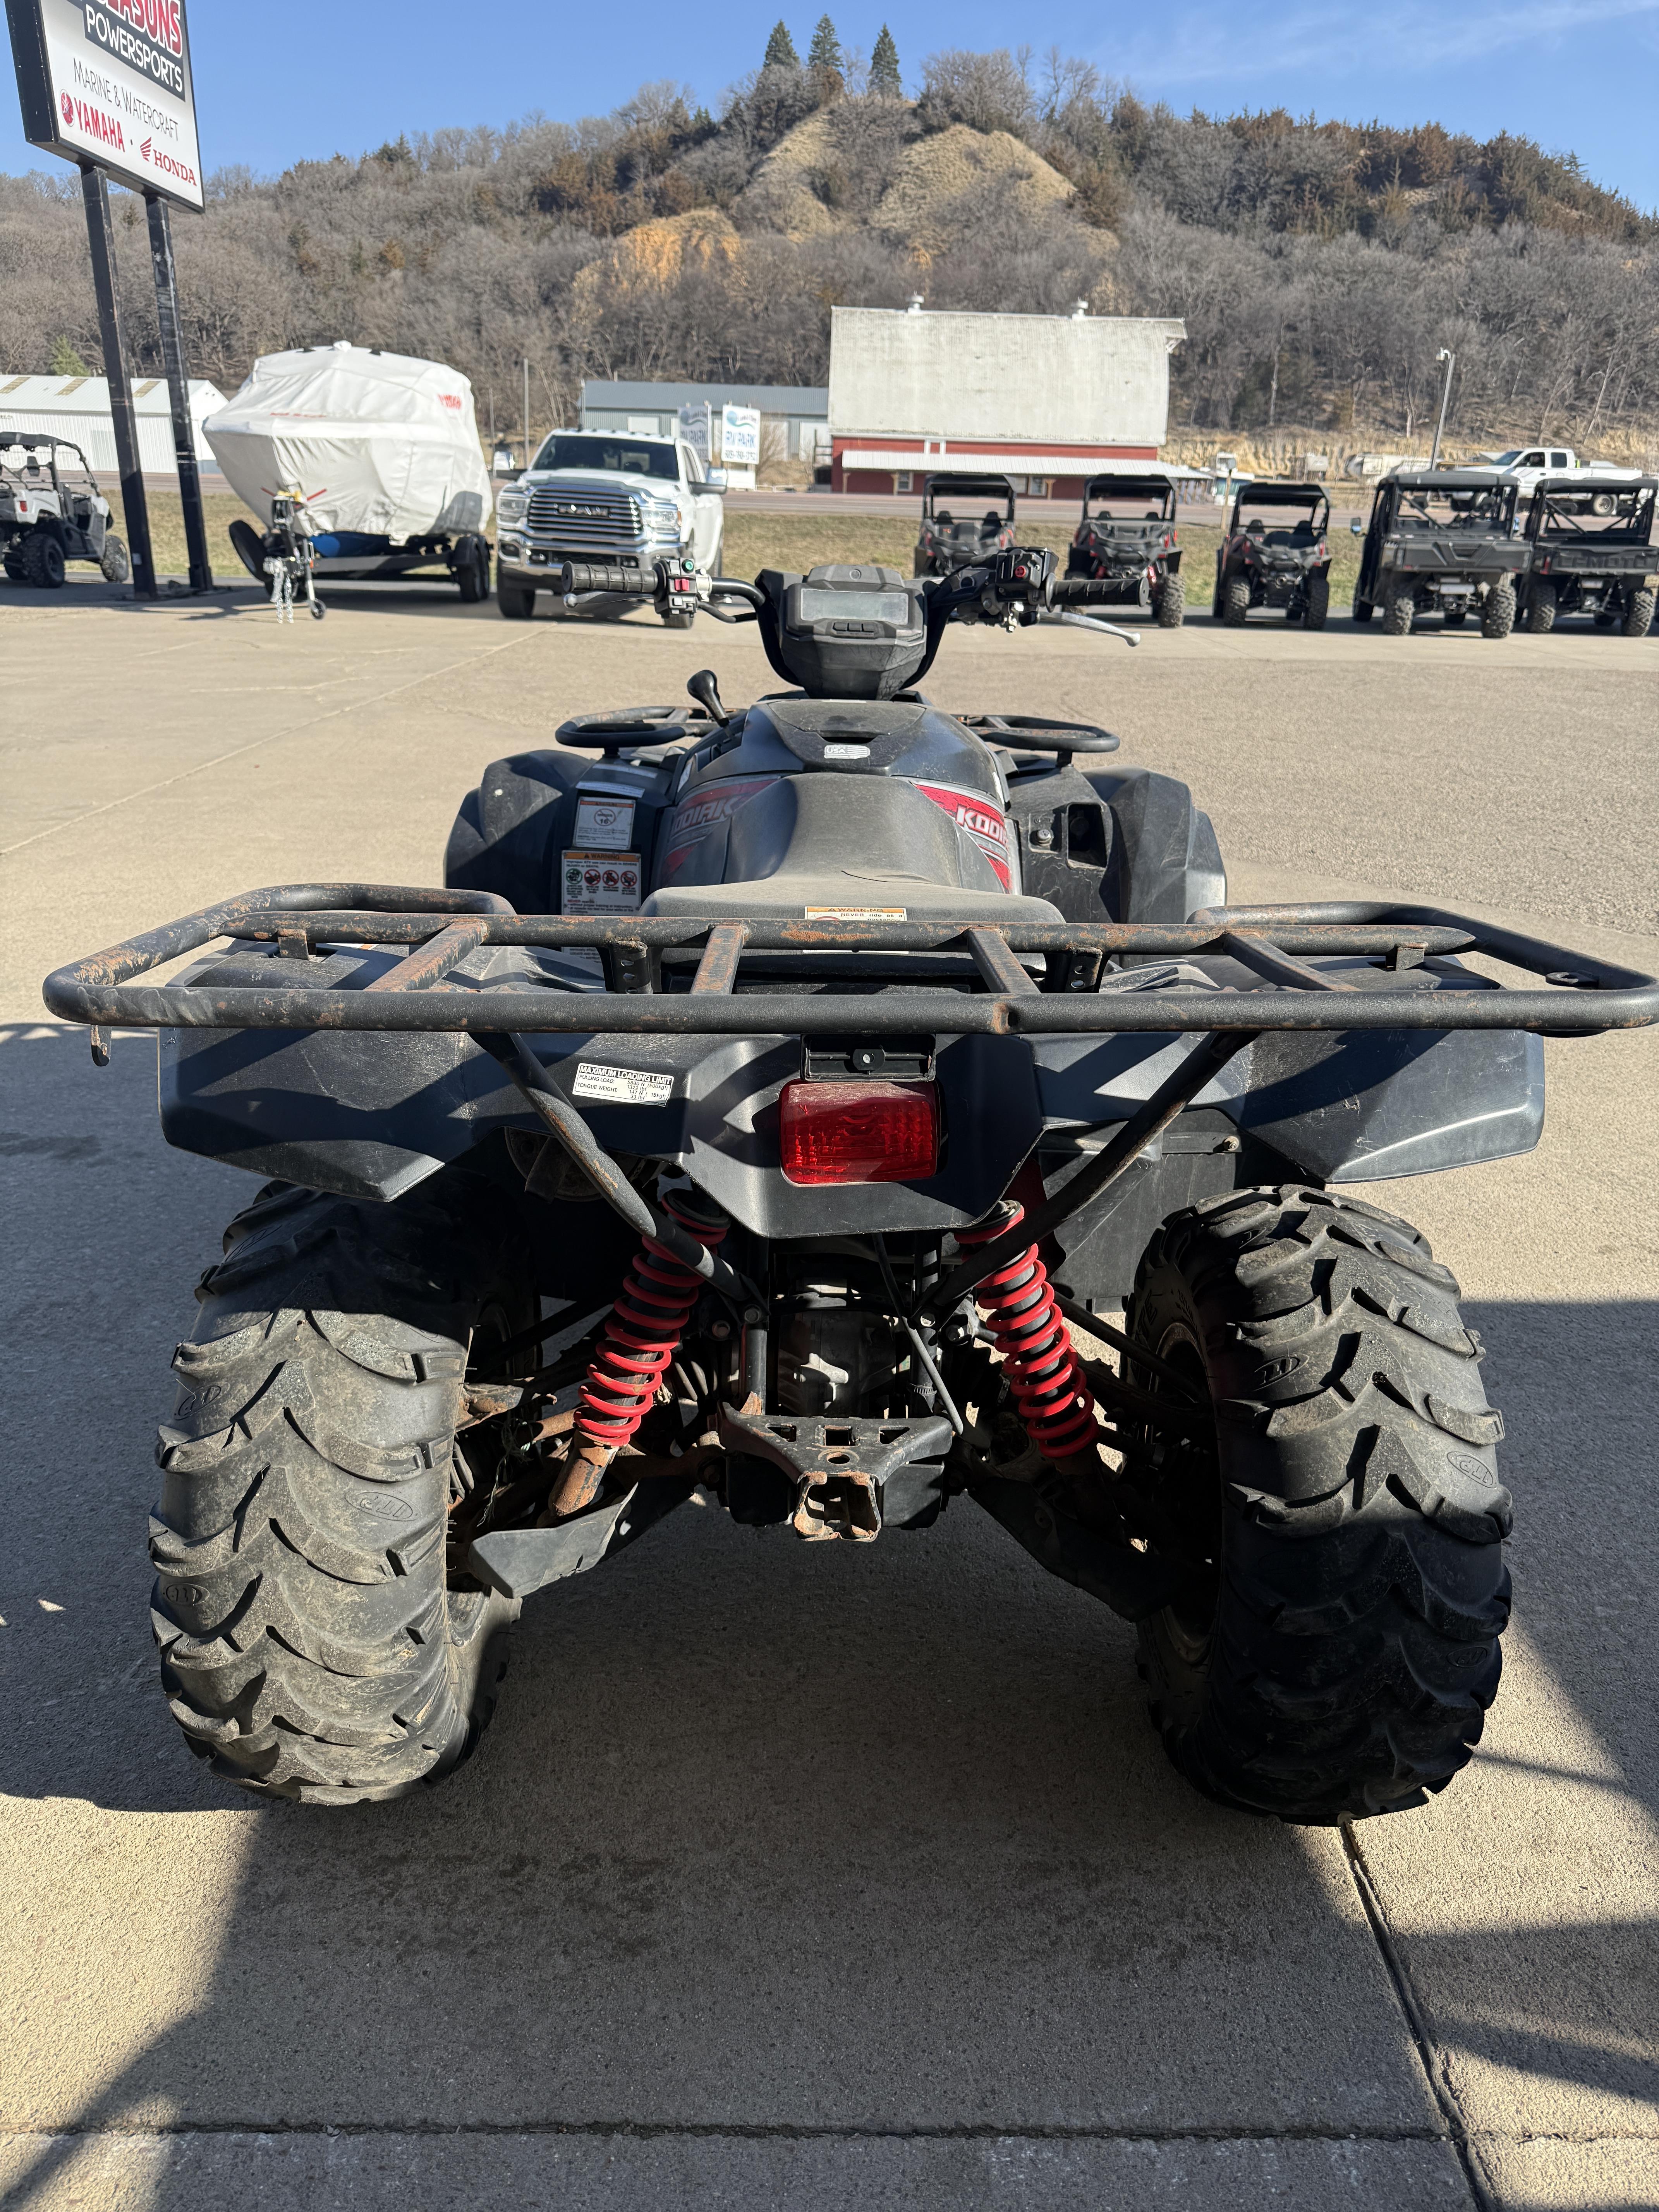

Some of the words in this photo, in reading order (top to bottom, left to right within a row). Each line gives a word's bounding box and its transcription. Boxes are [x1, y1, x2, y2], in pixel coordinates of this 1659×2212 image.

[86, 4, 183, 92] POWERSPORTS
[74, 57, 112, 103] MARINE
[114, 85, 122, 109] &
[122, 87, 179, 141] WATERCRAFT
[74, 97, 125, 153] YAMAHA
[153, 149, 198, 187] HONDA
[580, 1065, 617, 1078] MAXIMUM
[617, 1071, 651, 1082] LOADING
[651, 1075, 672, 1085] LIMIT
